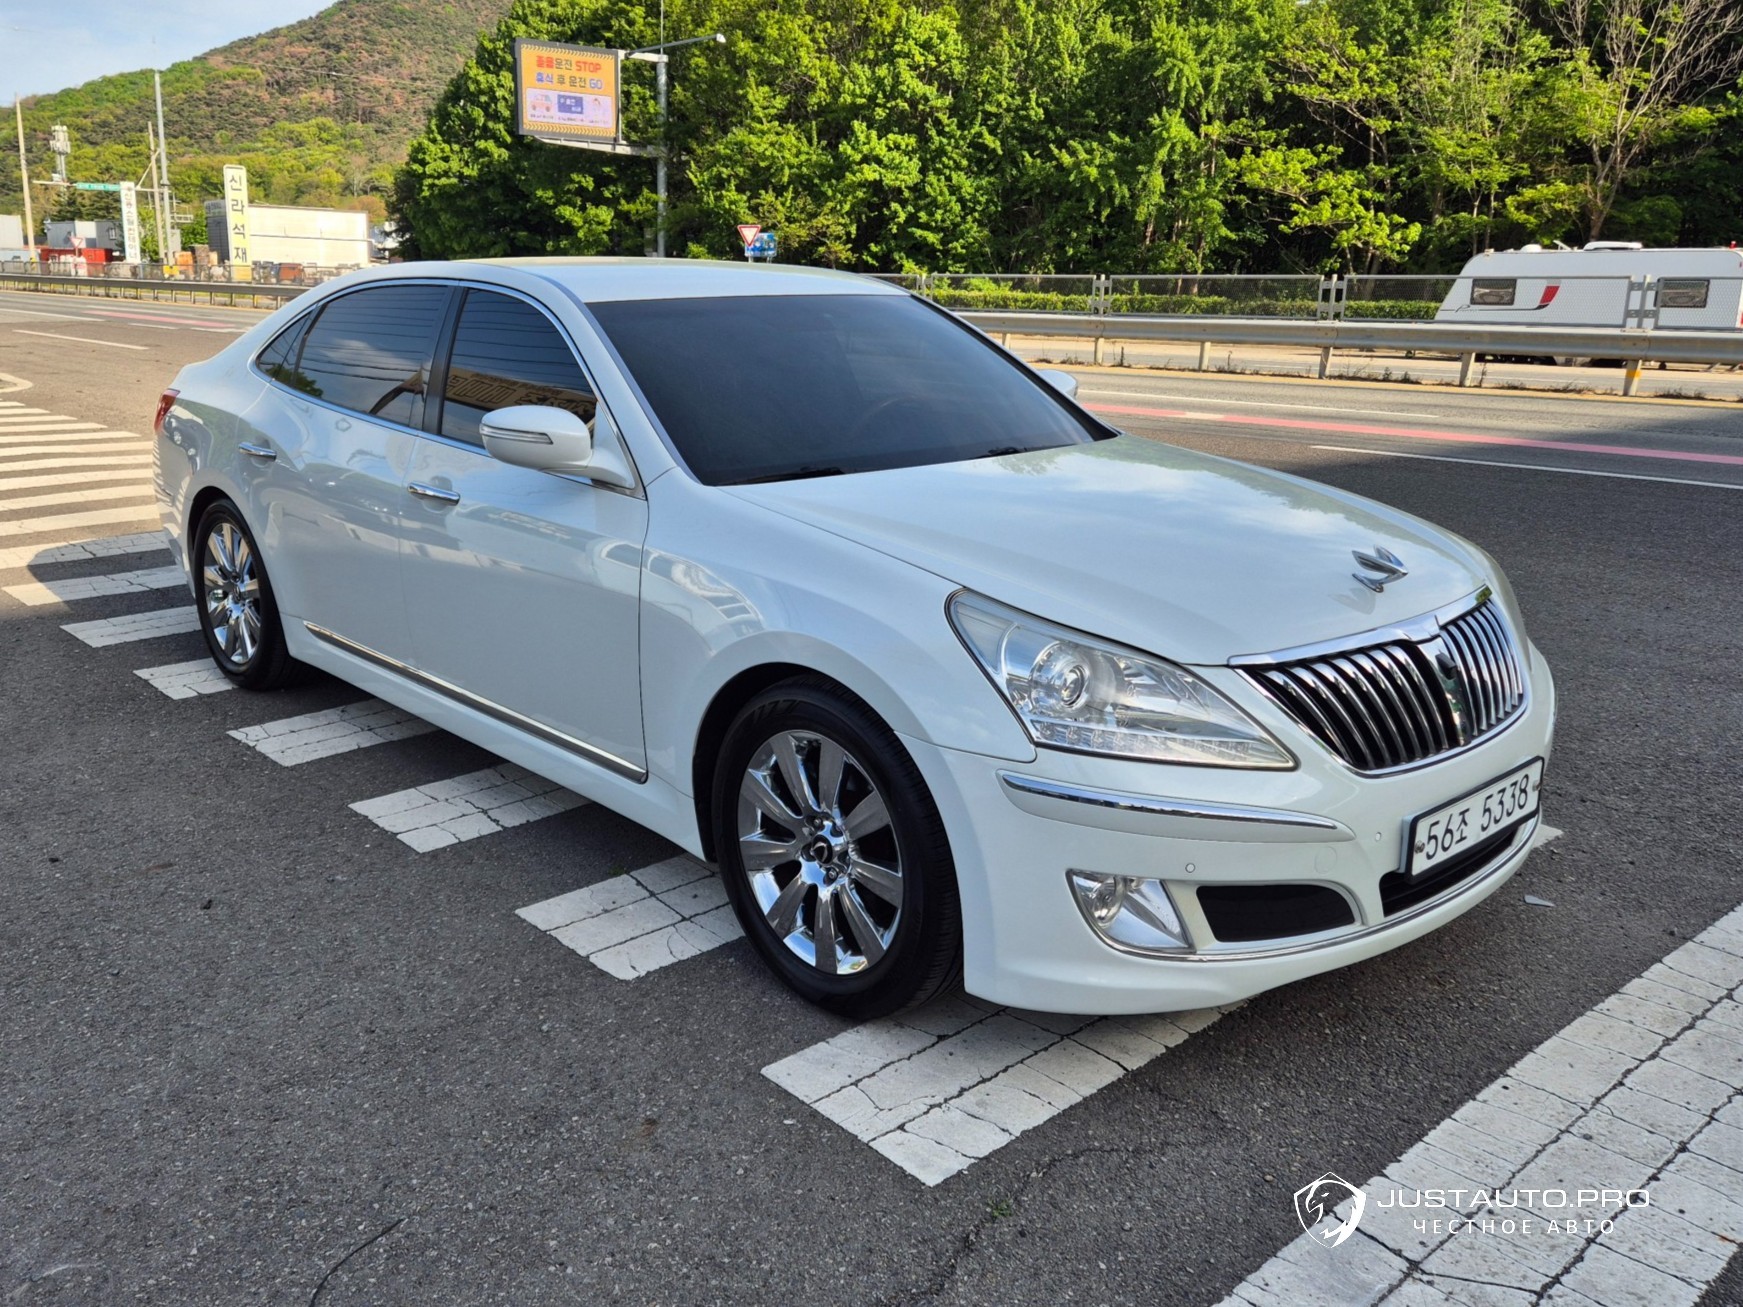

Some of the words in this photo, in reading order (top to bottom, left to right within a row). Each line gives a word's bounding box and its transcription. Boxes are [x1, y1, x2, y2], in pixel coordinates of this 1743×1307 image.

[569, 75, 587, 88] 운전
[589, 78, 603, 90] GO
[575, 60, 602, 73] STOP
[229, 175, 248, 264] 신라석재
[1425, 808, 1470, 861] 56조
[1481, 773, 1530, 832] 5338
